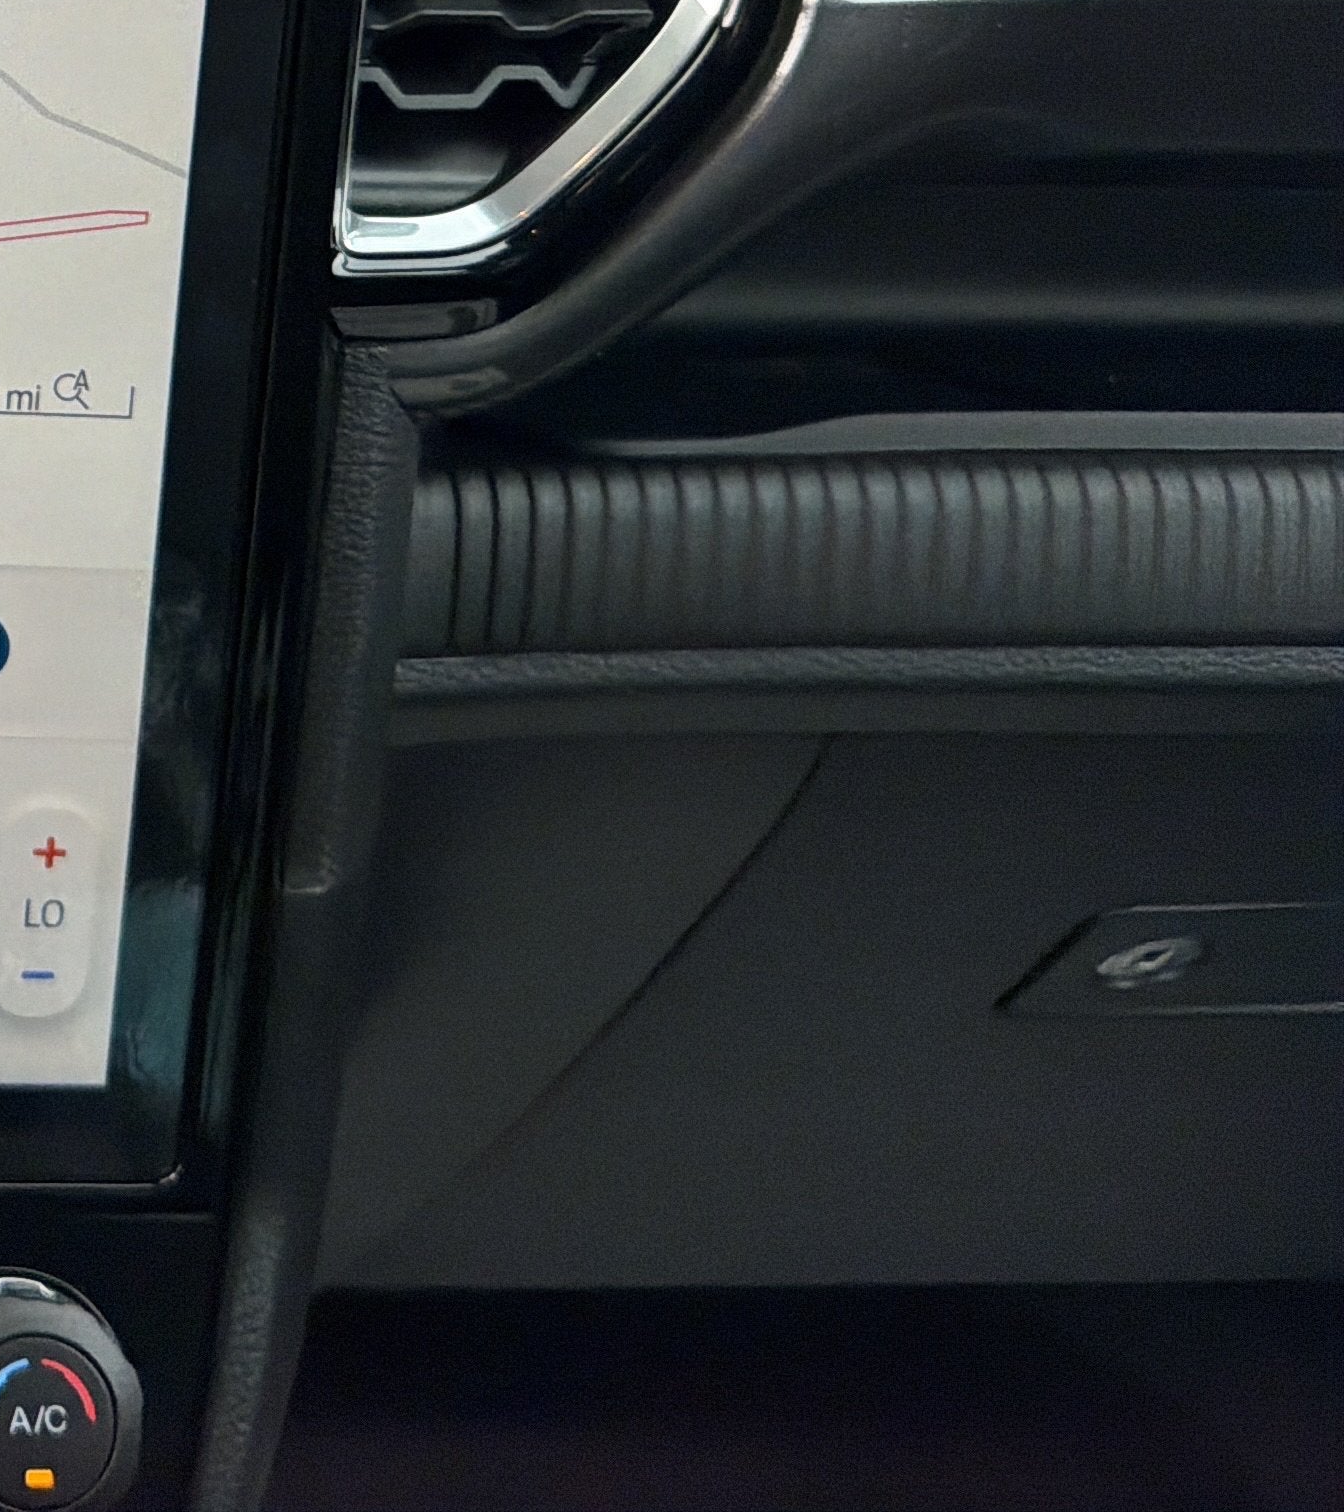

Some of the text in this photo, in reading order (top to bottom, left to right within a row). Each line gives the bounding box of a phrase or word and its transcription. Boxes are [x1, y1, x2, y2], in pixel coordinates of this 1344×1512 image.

[6, 384, 42, 411] mi
[23, 898, 65, 929] LO
[9, 1404, 68, 1434] A/C
